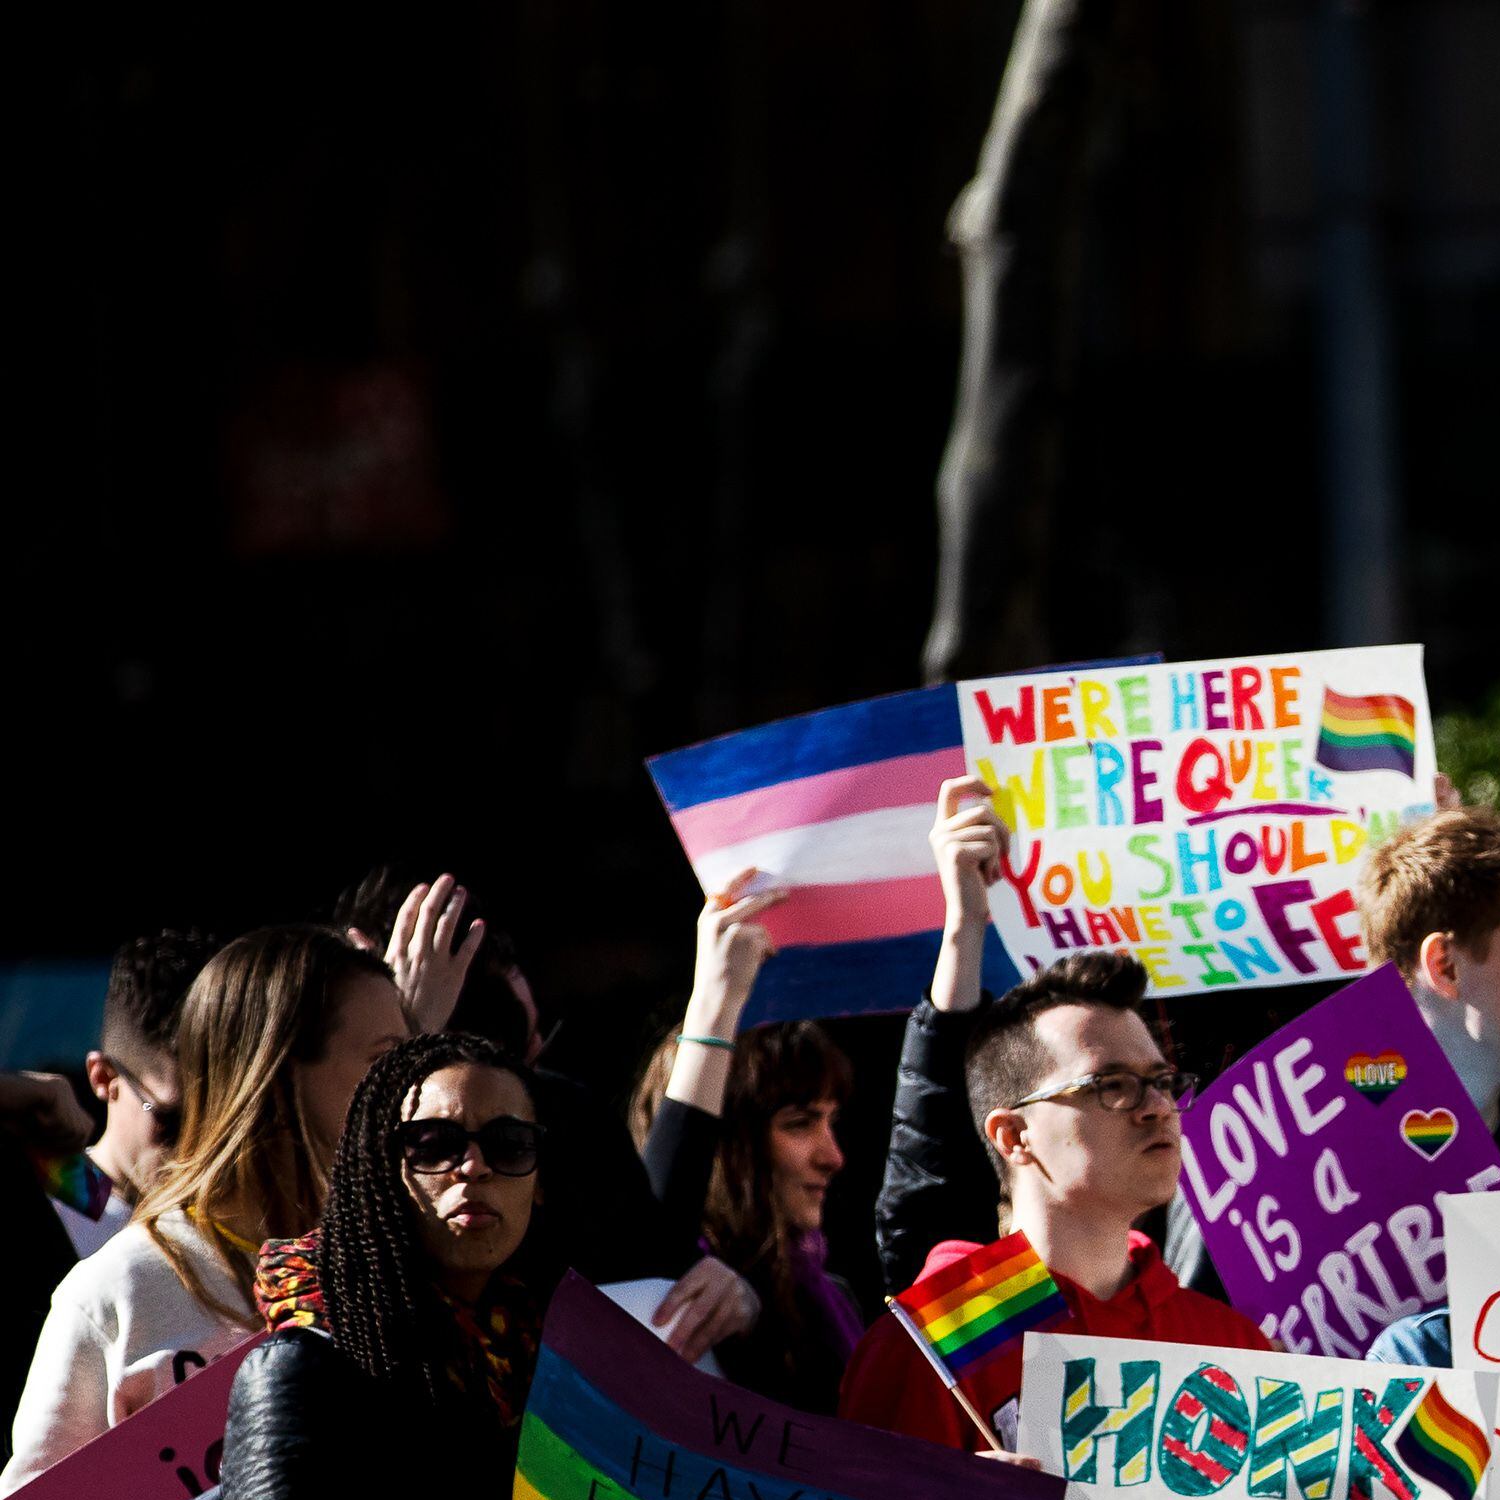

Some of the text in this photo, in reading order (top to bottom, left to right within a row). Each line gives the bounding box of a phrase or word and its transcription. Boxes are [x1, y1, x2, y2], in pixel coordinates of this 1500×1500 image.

[974, 667, 1301, 744] WE'RE HERE
[976, 739, 1163, 833] WE'RE
[1002, 839, 1113, 928] YOU
[1041, 899, 1247, 949] HAVE TO
[1182, 936, 1282, 988] IN
[1250, 880, 1368, 975] FE
[1354, 1062, 1400, 1087] LOVE
[1181, 1037, 1346, 1223] LOVE
[1313, 1147, 1361, 1214] a
[708, 1393, 821, 1475] WE
